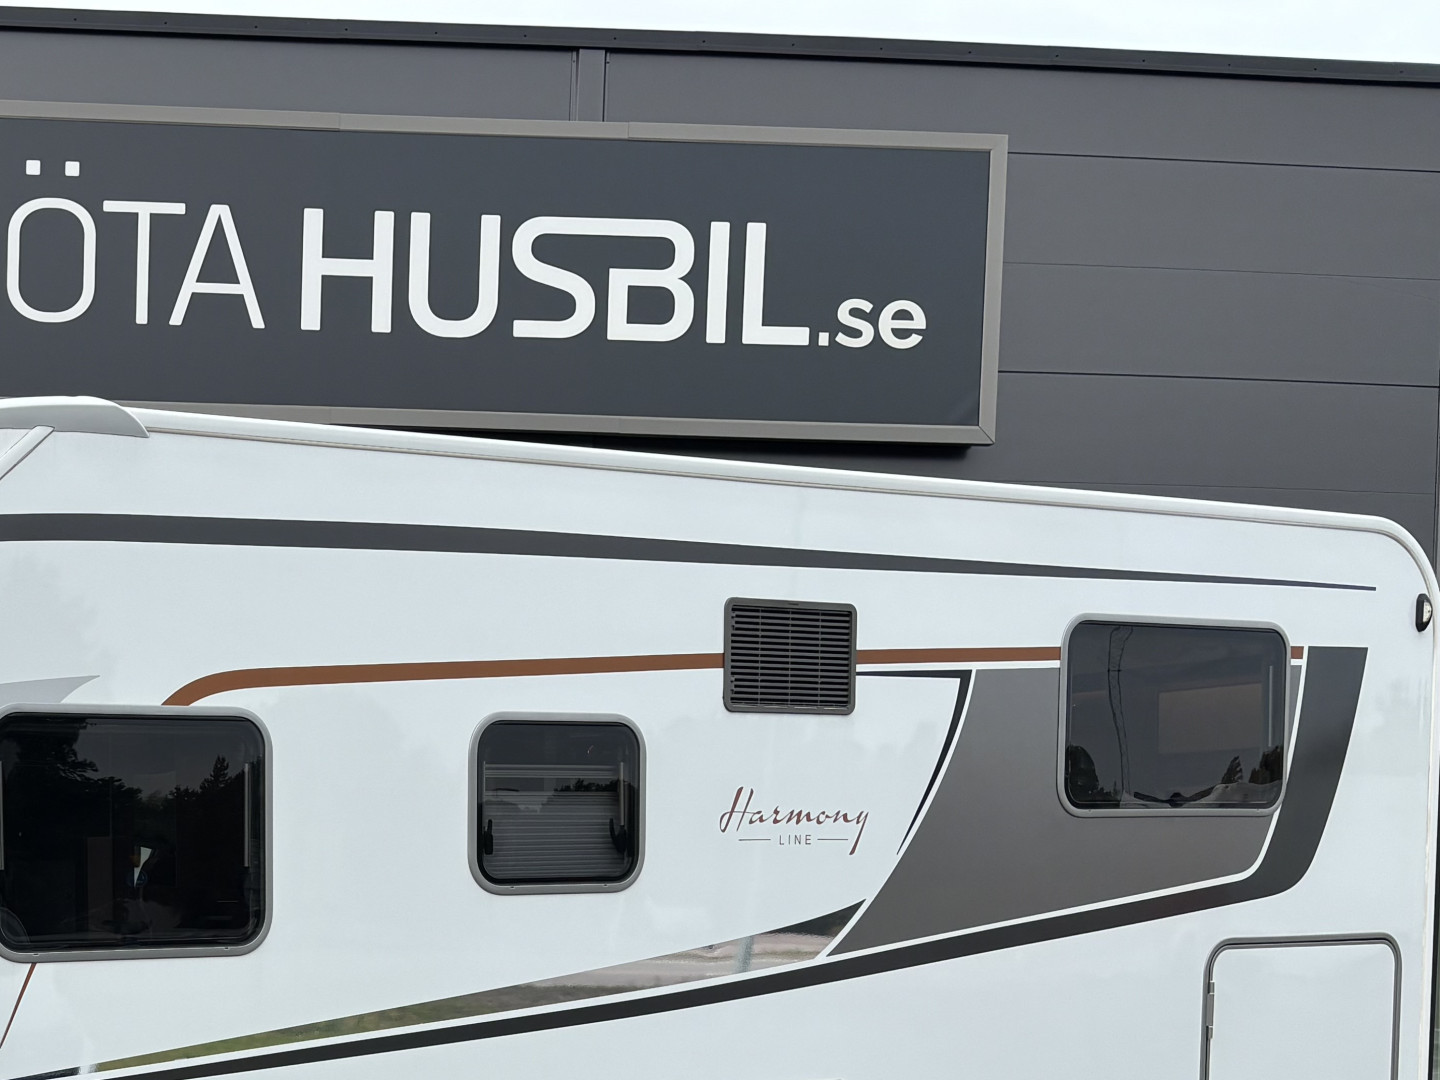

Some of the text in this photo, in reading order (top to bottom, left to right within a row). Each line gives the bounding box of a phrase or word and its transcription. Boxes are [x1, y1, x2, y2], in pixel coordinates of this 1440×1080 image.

[301, 208, 927, 349] HUSBIL.se
[719, 786, 869, 856] Harmony
[778, 834, 812, 846] LINE
